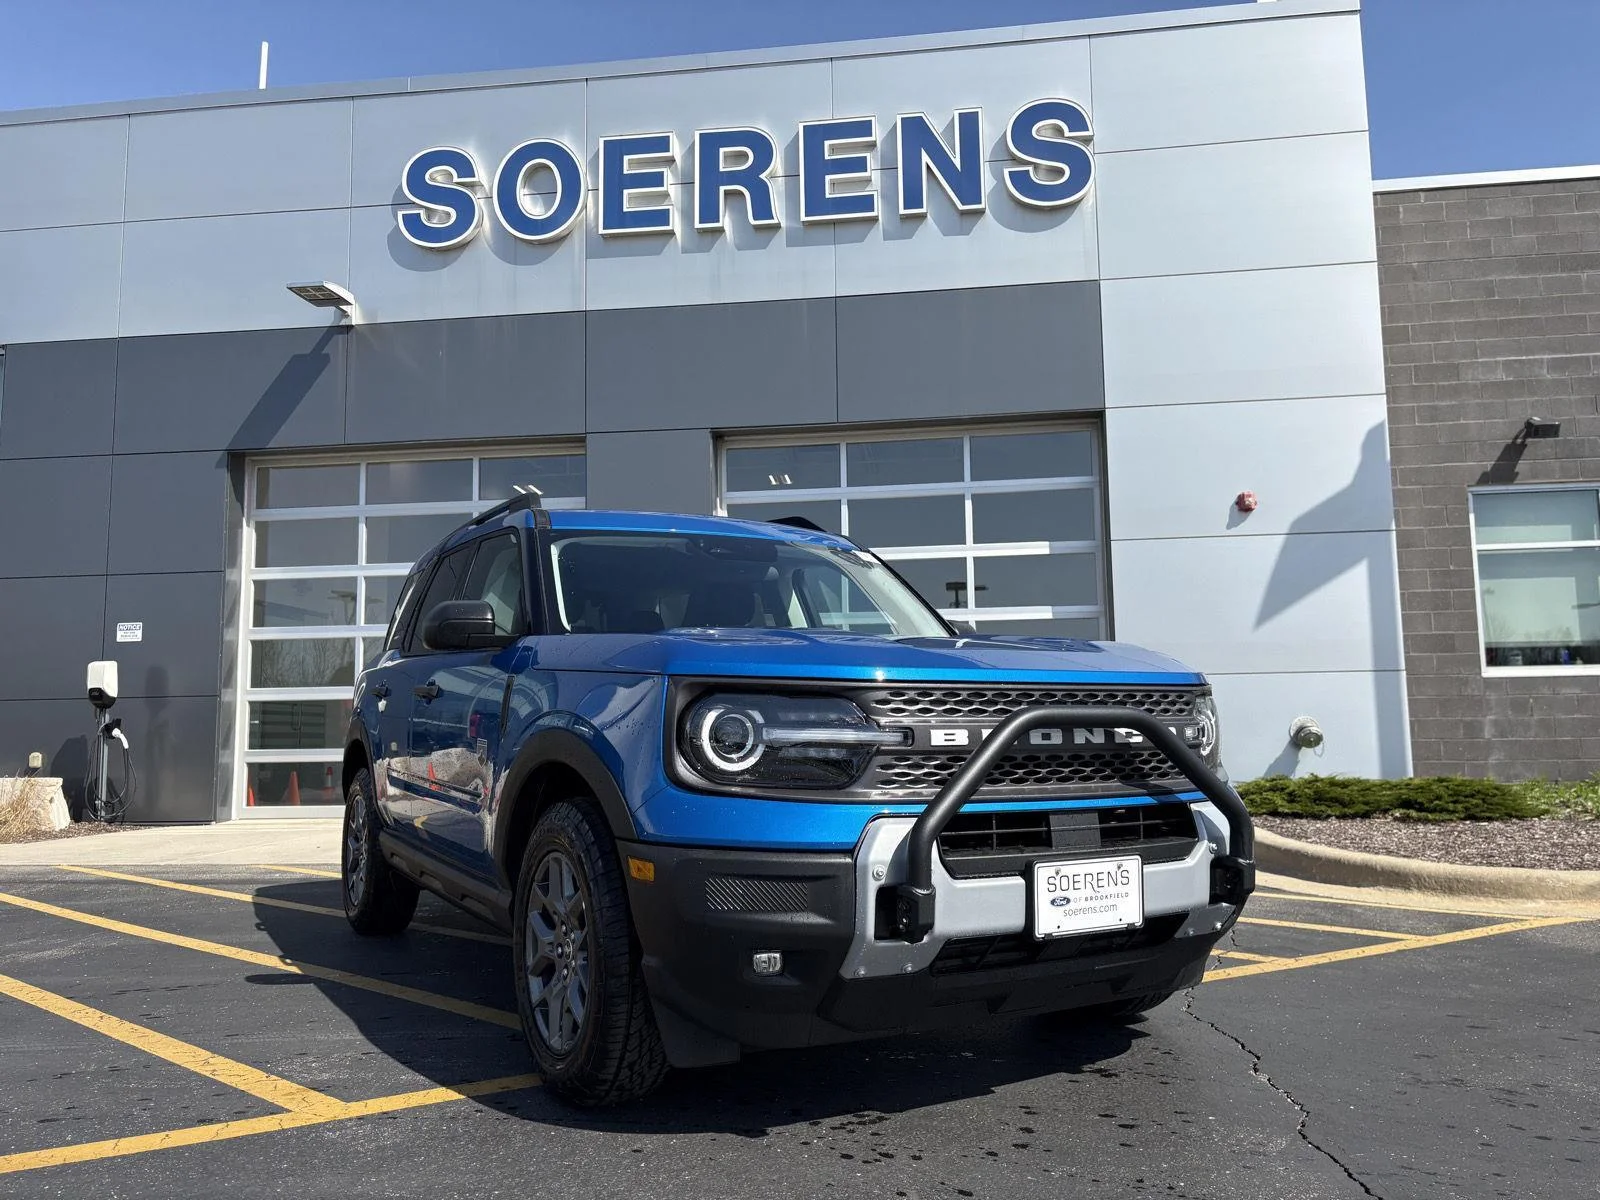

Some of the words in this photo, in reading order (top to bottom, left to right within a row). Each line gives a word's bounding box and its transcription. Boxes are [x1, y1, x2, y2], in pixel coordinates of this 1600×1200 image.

[396, 98, 1095, 250] SOERENS
[1047, 869, 1129, 893] SOERENS
[1085, 892, 1129, 901] BROOKFIELD
[1063, 904, 1117, 917] soerens.com
